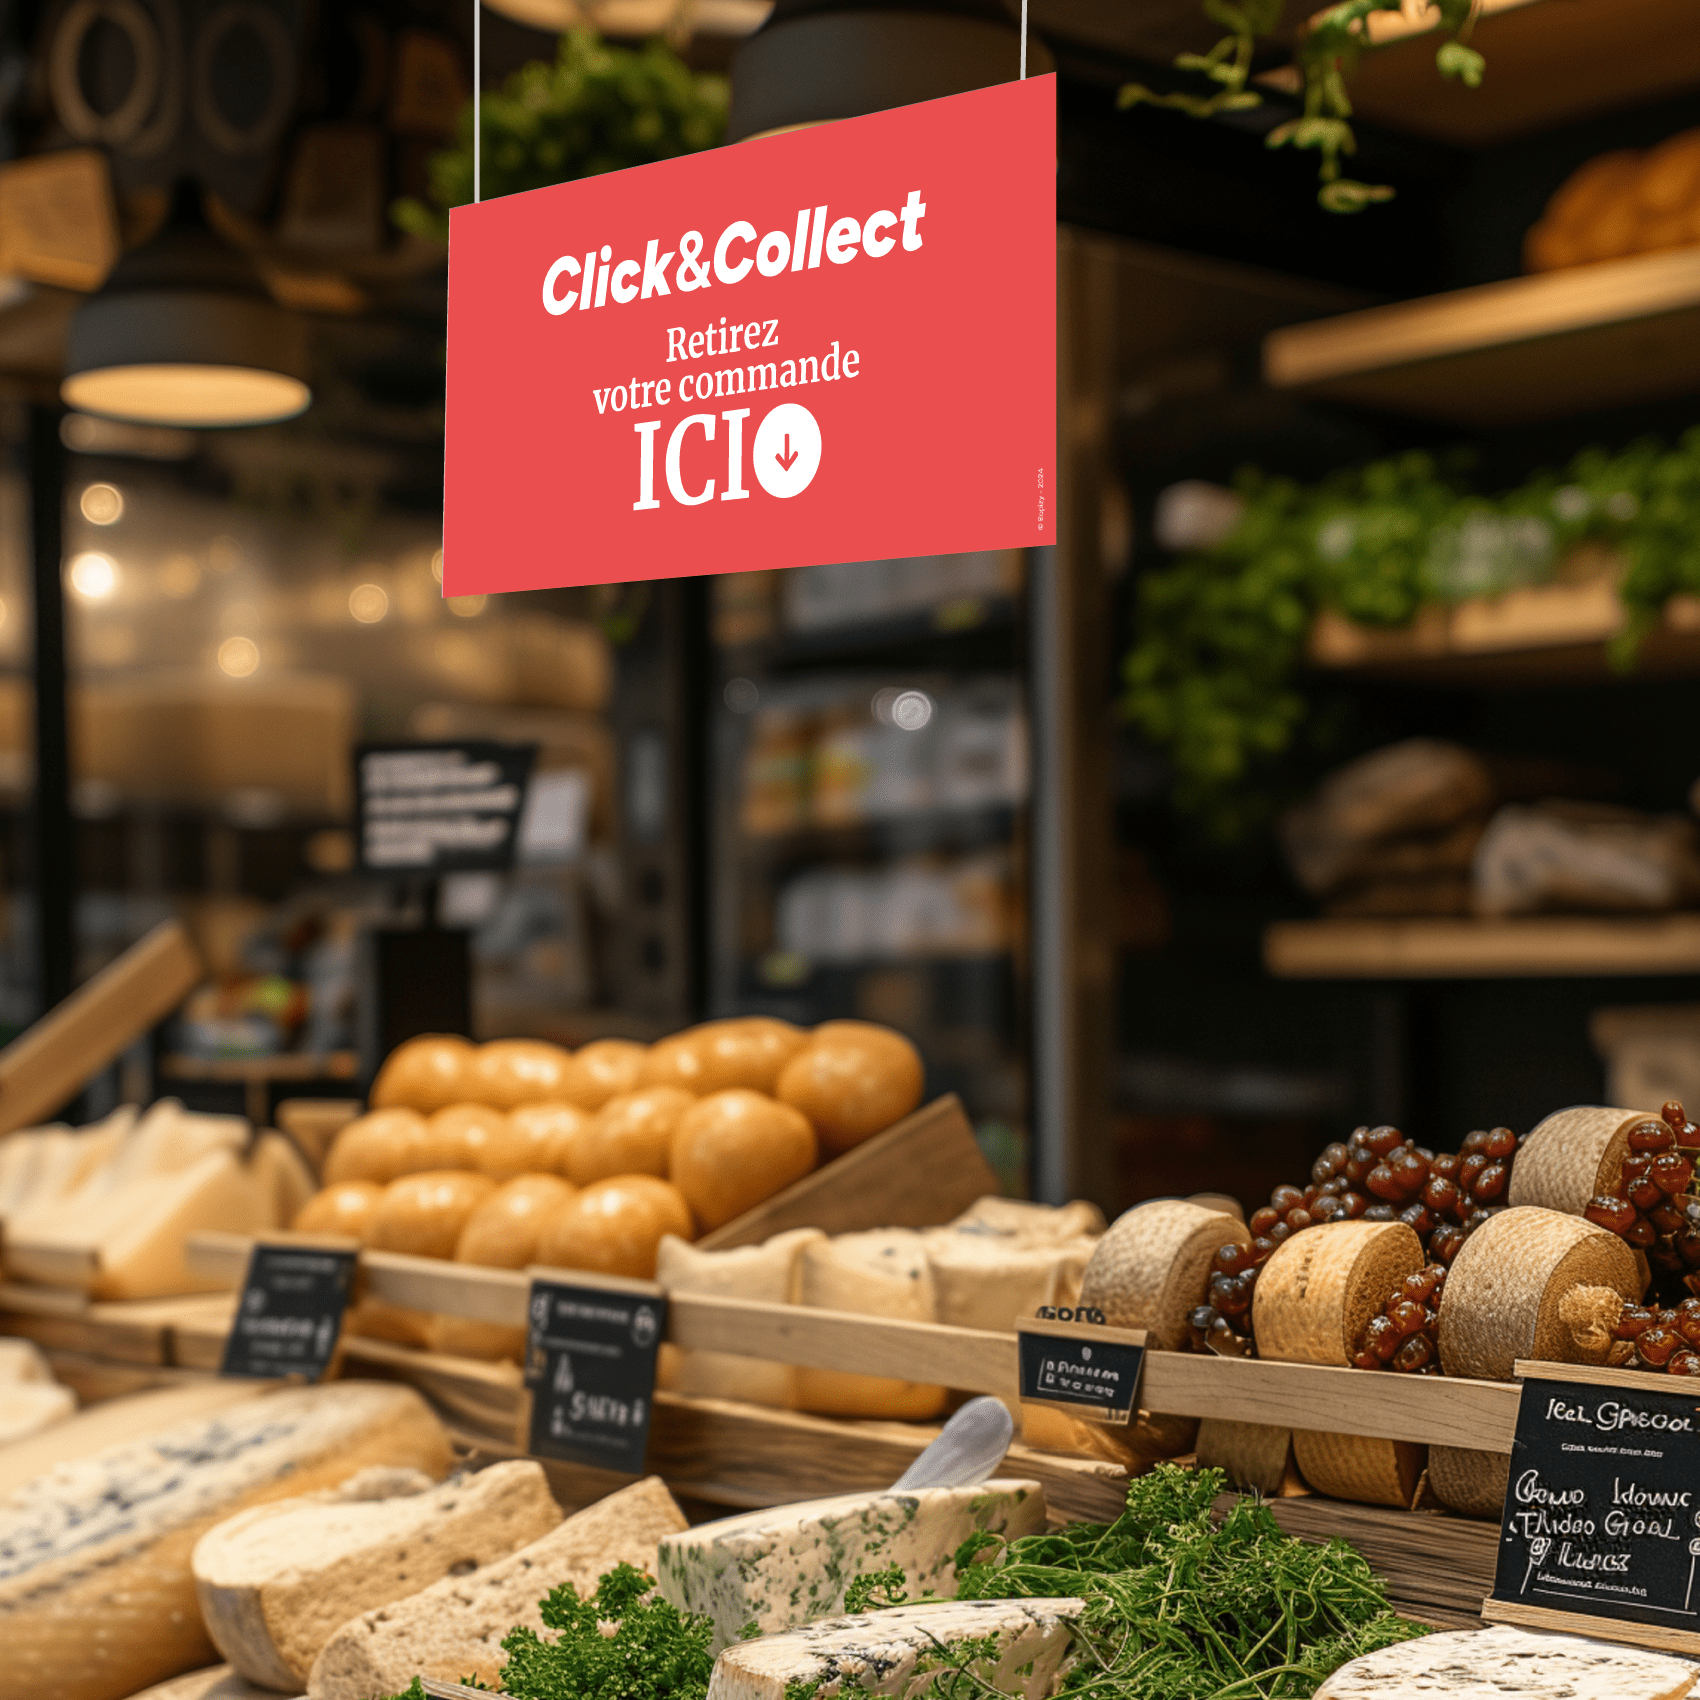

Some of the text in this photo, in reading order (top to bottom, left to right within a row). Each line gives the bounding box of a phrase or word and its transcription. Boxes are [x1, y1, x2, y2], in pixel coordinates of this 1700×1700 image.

[542, 190, 926, 315] Click&Collect
[666, 317, 779, 362] Retirez
[593, 341, 860, 414] votre commande
